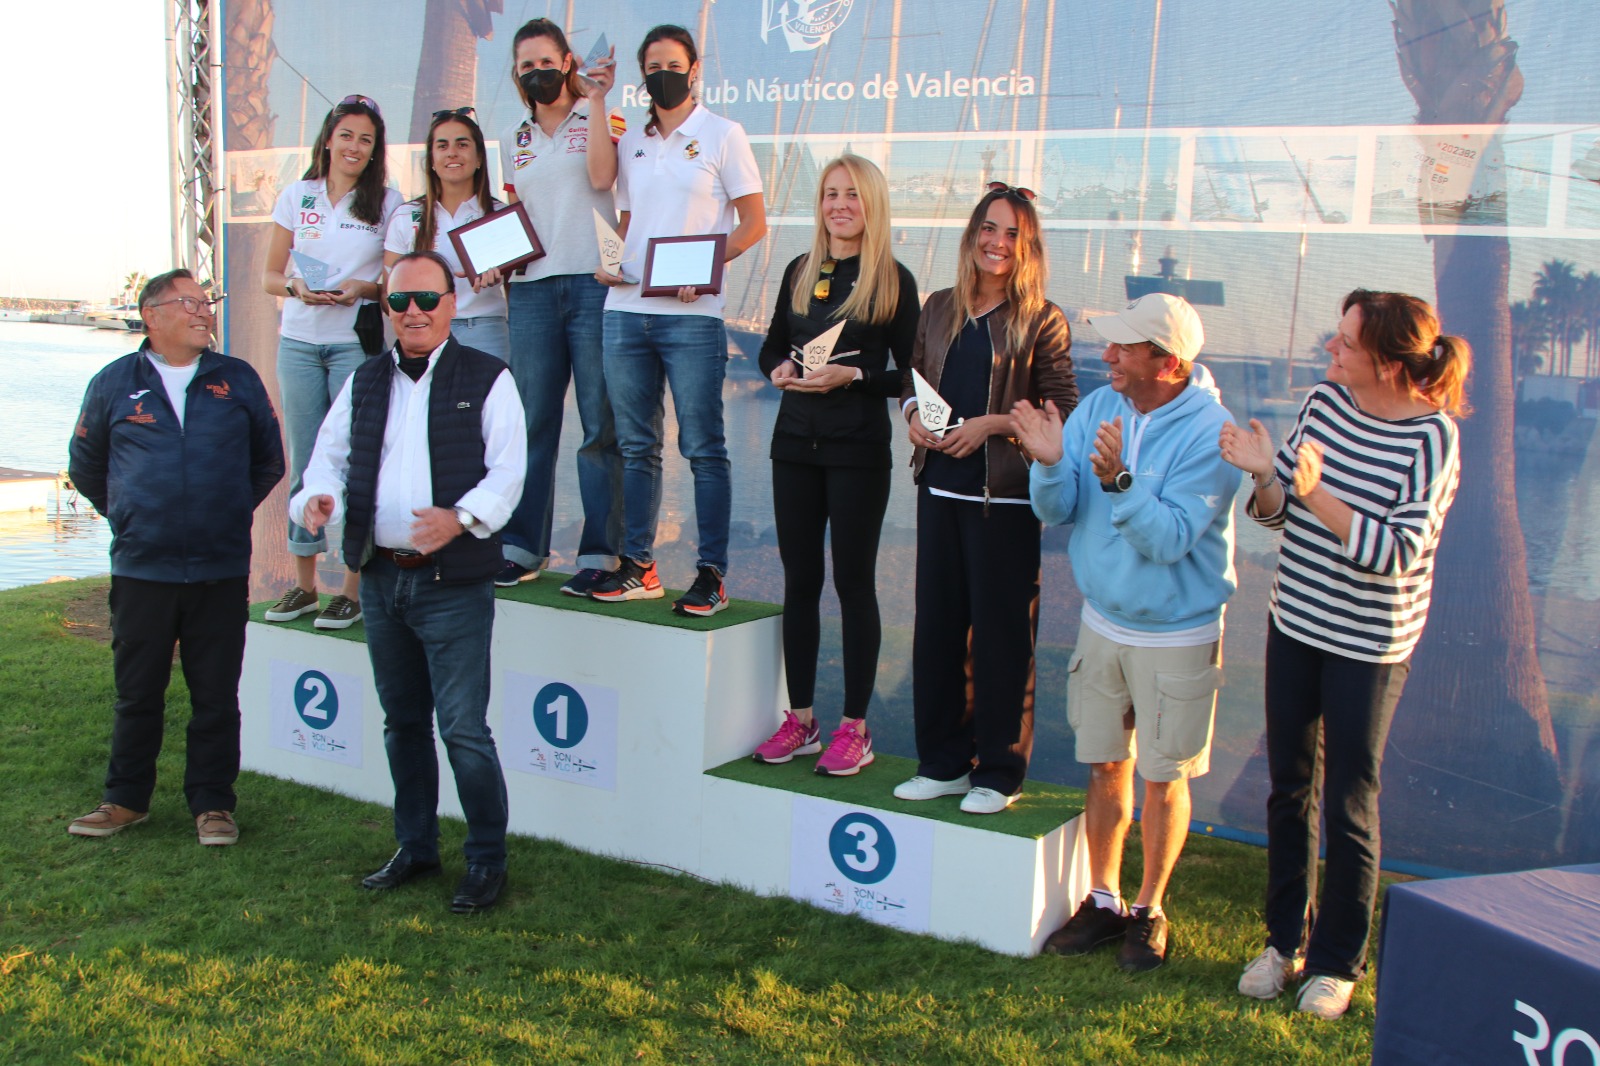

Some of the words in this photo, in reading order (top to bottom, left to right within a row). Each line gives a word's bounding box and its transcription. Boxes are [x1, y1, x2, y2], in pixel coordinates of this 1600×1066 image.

[794, 21, 837, 34] VALENCIA
[621, 84, 651, 108] Re
[698, 79, 739, 105] lub
[746, 76, 855, 103] Náutico
[862, 73, 899, 100] de
[905, 68, 1035, 98] Valencia
[1441, 142, 1477, 160] 202382
[1431, 173, 1448, 185] ESP
[924, 401, 945, 415] RCN
[922, 411, 941, 425] VLC
[303, 677, 328, 720] 2
[546, 694, 569, 741] 1
[554, 751, 571, 763] RCN
[843, 821, 880, 873] 3
[853, 887, 875, 900] RCN
[853, 897, 873, 910] VLC
